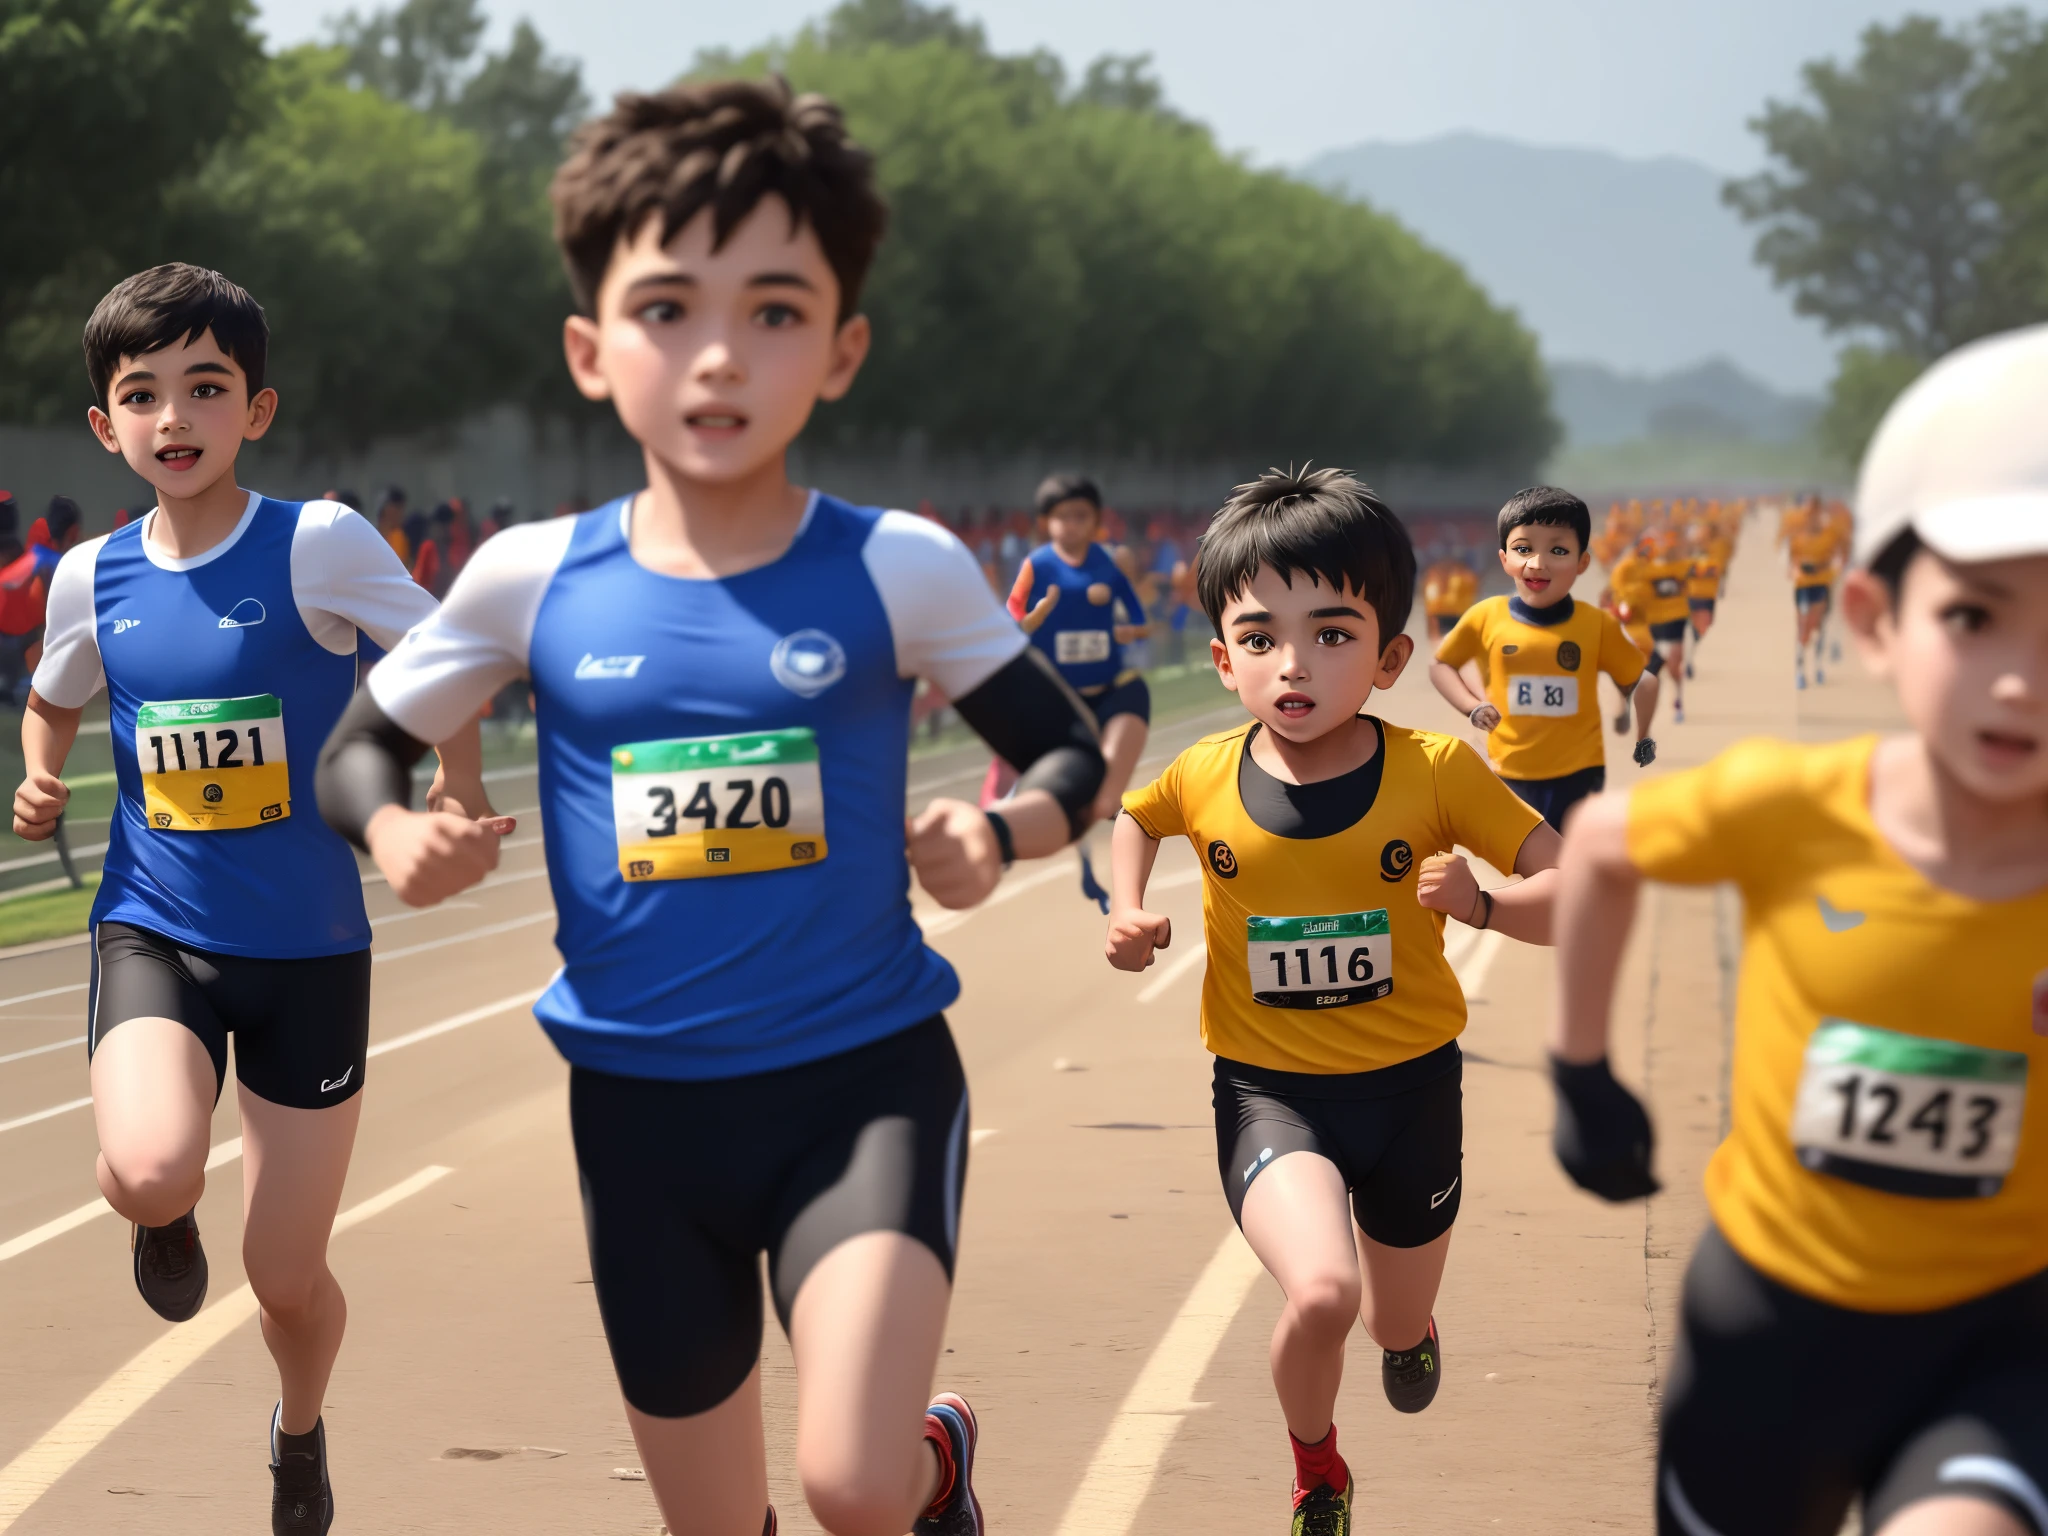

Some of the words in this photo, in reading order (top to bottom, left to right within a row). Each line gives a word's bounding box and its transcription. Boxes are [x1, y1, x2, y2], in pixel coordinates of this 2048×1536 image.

[150, 727, 265, 774] 11121
[1270, 945, 1374, 987] 1116
[1831, 1073, 1999, 1161] 1243
